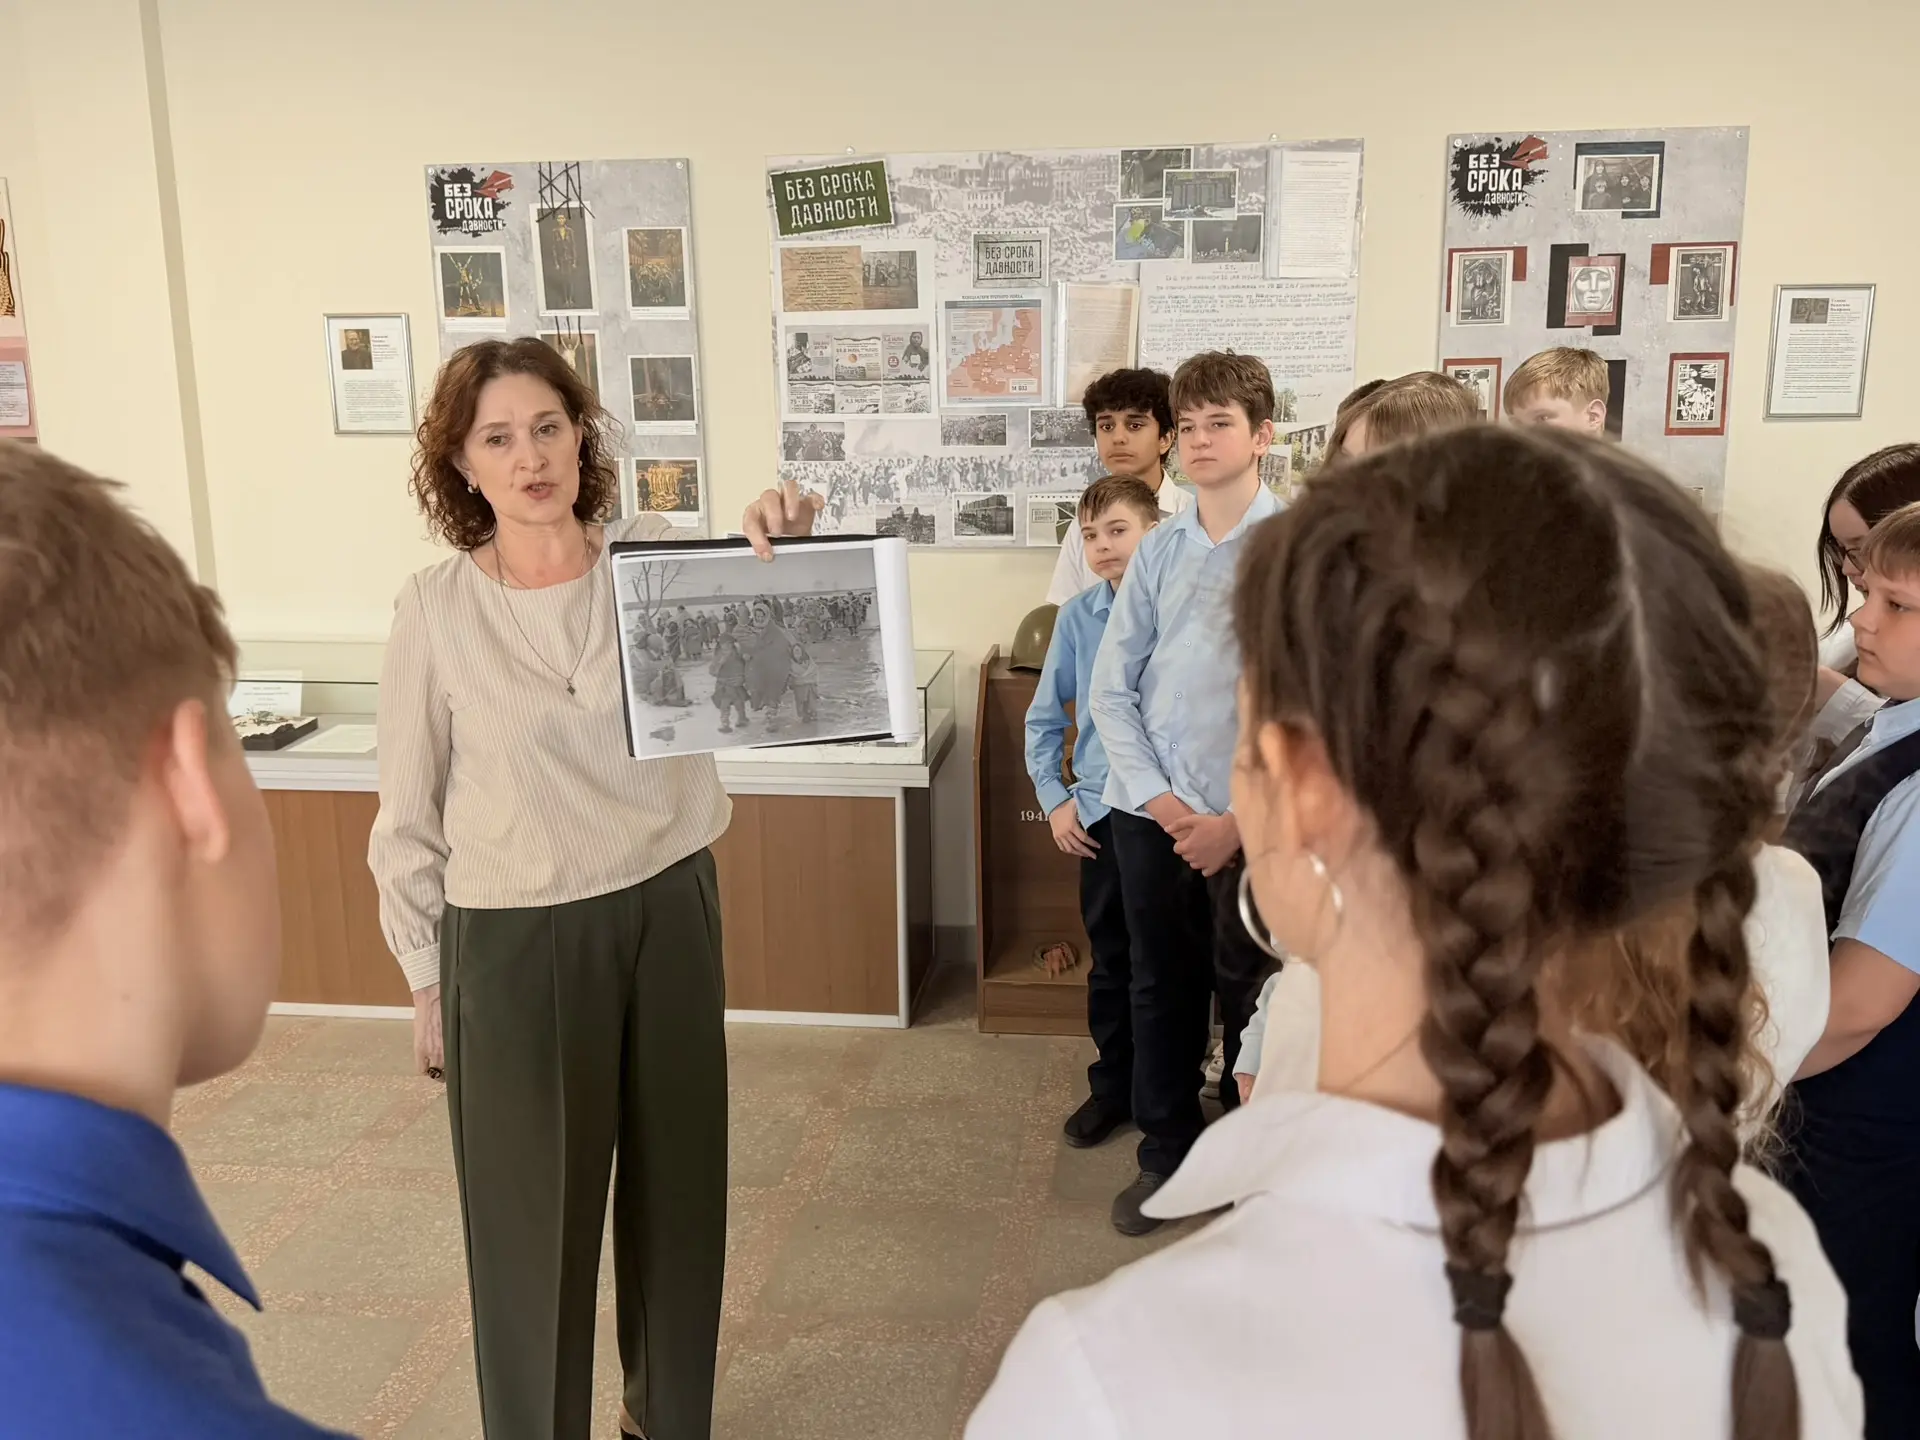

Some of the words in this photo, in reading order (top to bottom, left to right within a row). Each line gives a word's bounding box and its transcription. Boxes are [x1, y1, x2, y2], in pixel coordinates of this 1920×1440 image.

[1468, 153, 1500, 169] БЕЗ
[784, 176, 815, 201] БЕЗ
[820, 169, 876, 197] СРОКА
[1467, 168, 1523, 193] СРОКА
[443, 183, 472, 198] БЕЗ
[445, 197, 494, 220] СРОКА
[791, 195, 879, 229] ДАВНОСТИ
[985, 247, 1002, 260] БЕЗ
[1004, 245, 1035, 259] СРОКА
[985, 259, 1035, 275] ДАВНОСТИ
